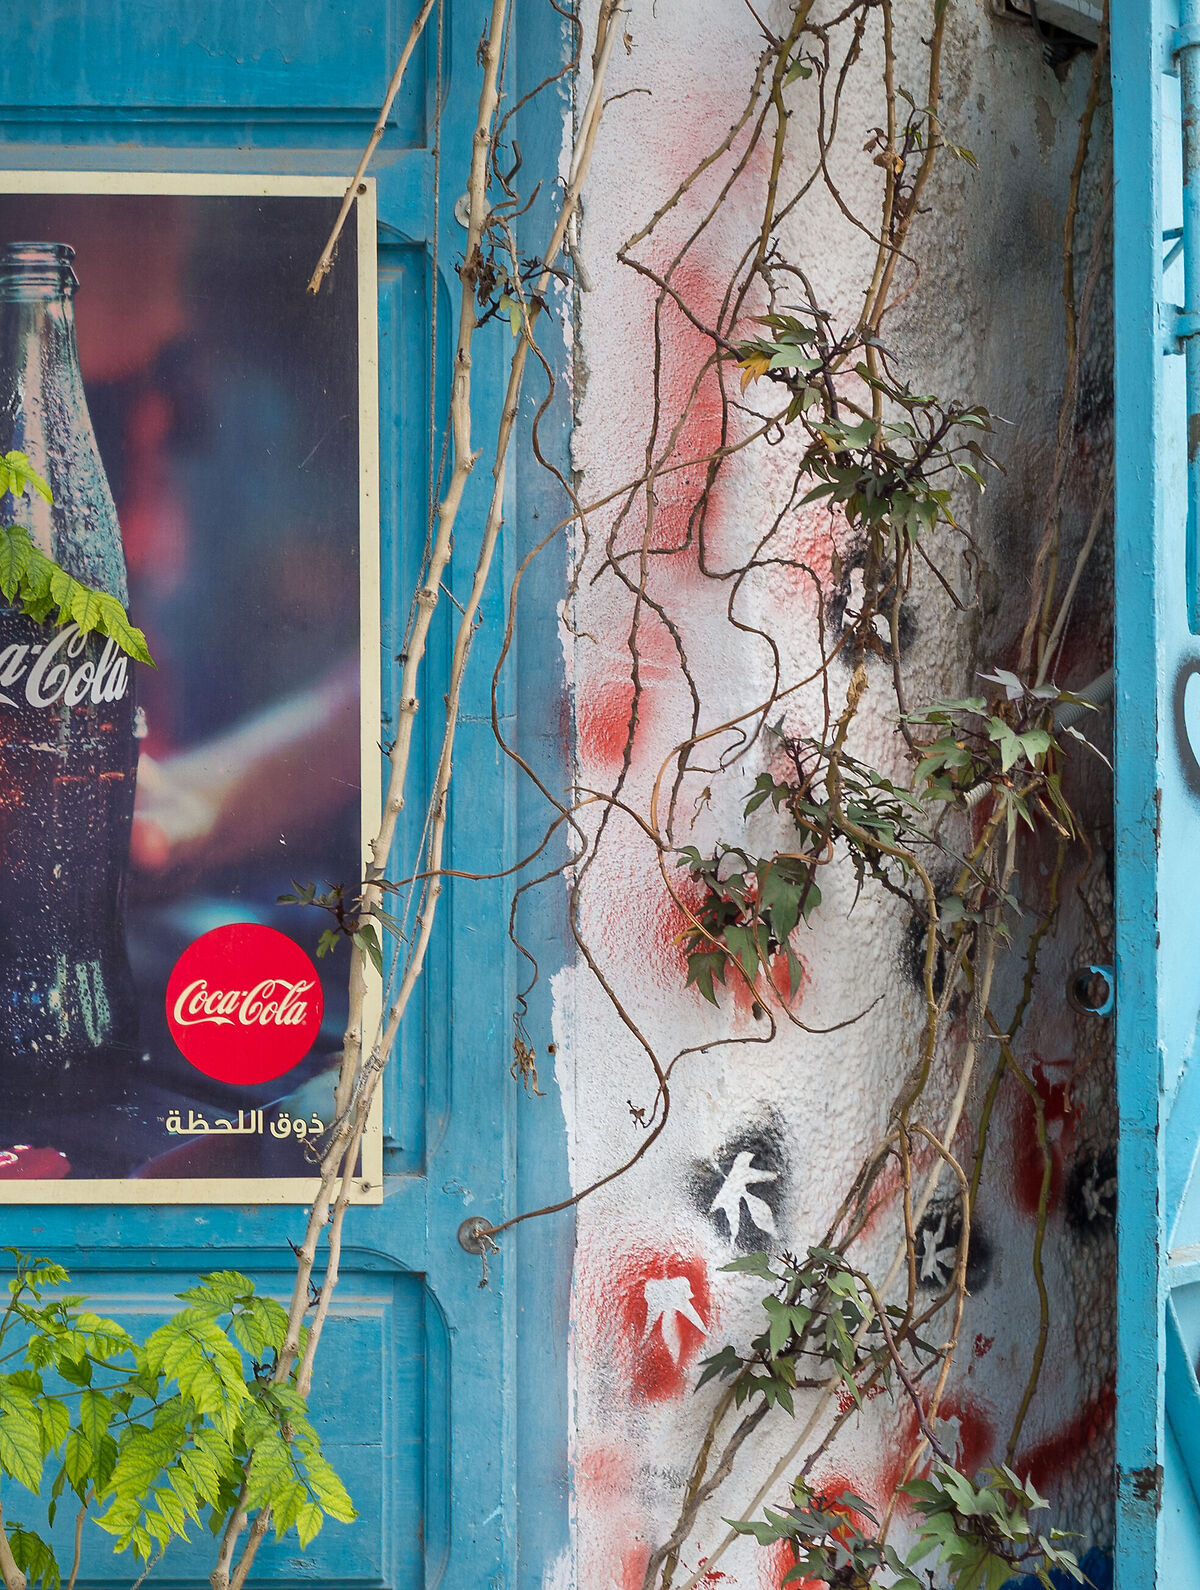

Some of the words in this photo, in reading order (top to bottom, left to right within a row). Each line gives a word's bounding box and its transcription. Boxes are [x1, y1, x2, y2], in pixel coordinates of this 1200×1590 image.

[173, 978, 315, 1026] Coca-Cola
[165, 1109, 264, 1135] اللحظة
[270, 1112, 325, 1139] ذوق
